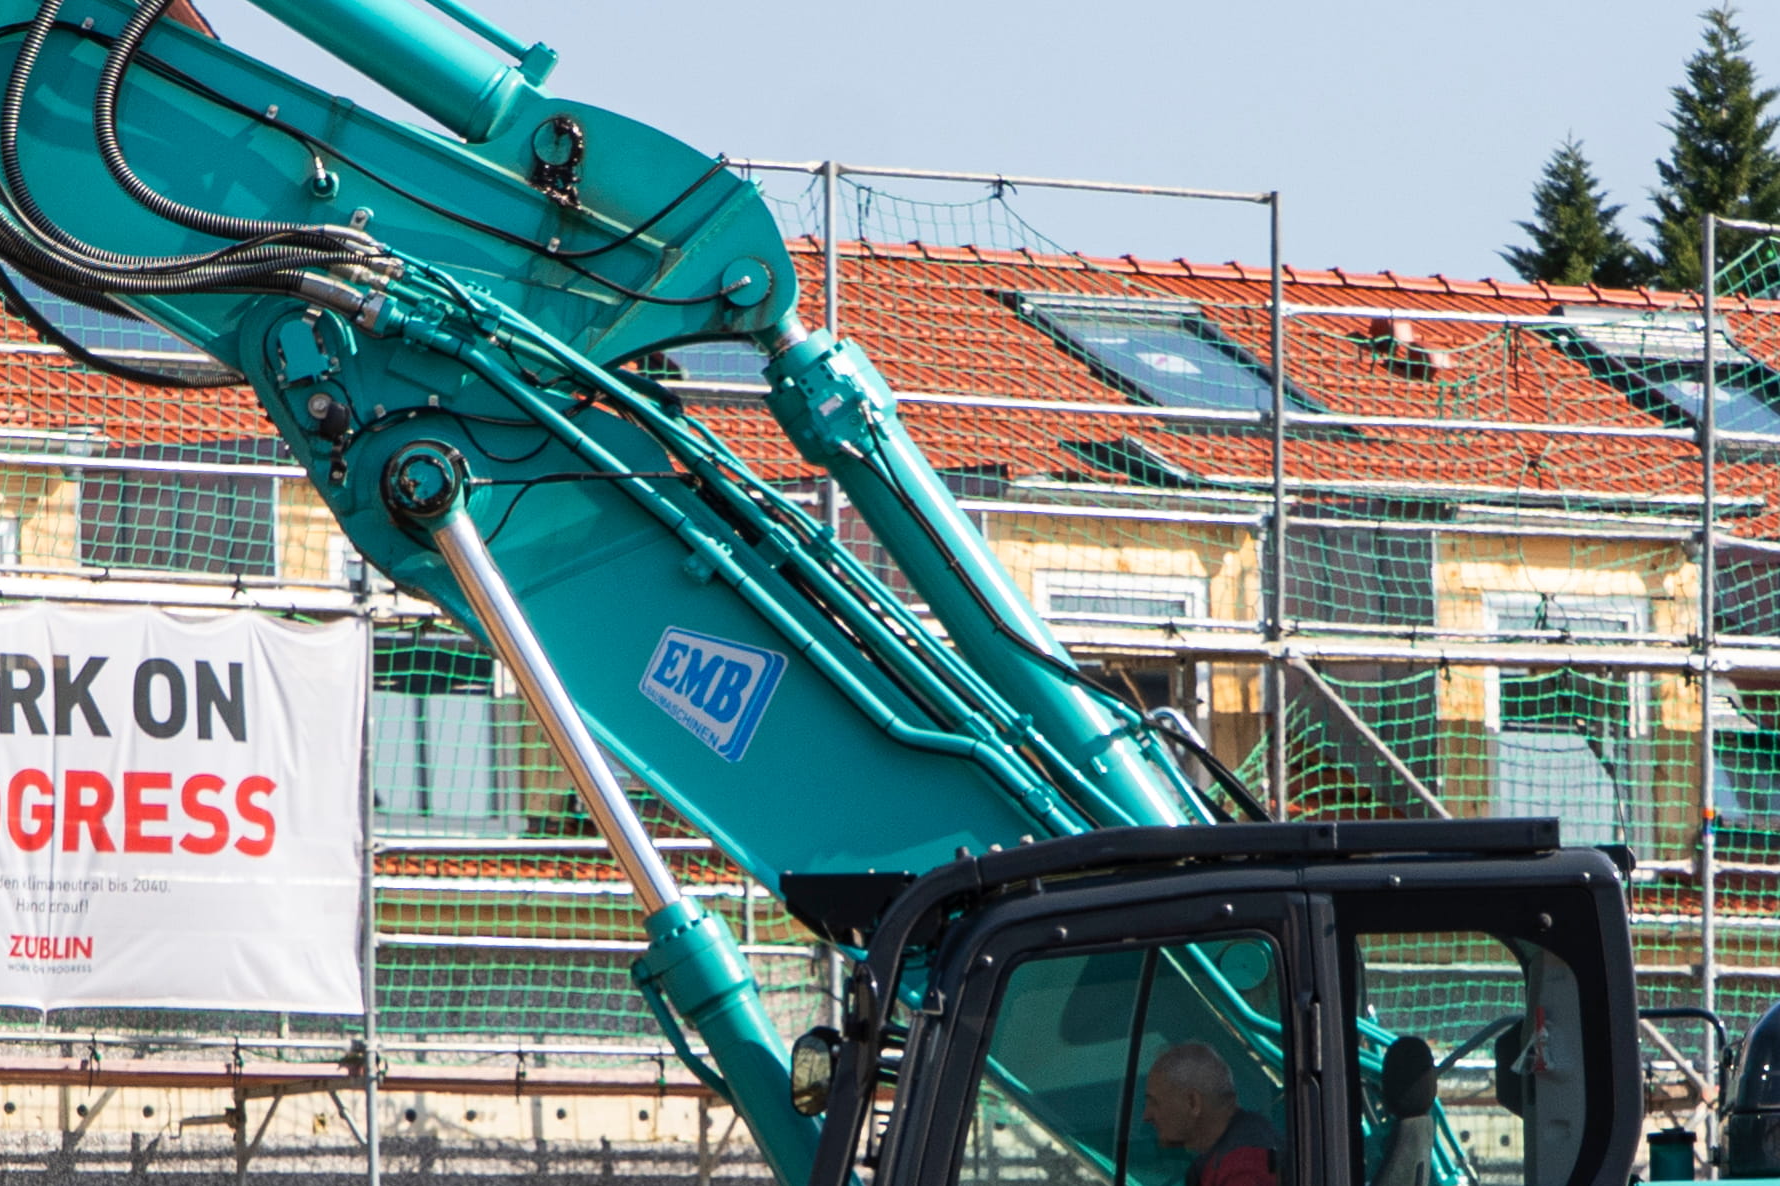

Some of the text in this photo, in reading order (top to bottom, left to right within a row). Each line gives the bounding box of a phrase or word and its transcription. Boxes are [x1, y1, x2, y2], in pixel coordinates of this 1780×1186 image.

[133, 657, 247, 742] ON
[652, 640, 753, 723] EMB
[108, 877, 128, 893] bis
[133, 879, 172, 894] 2040.
